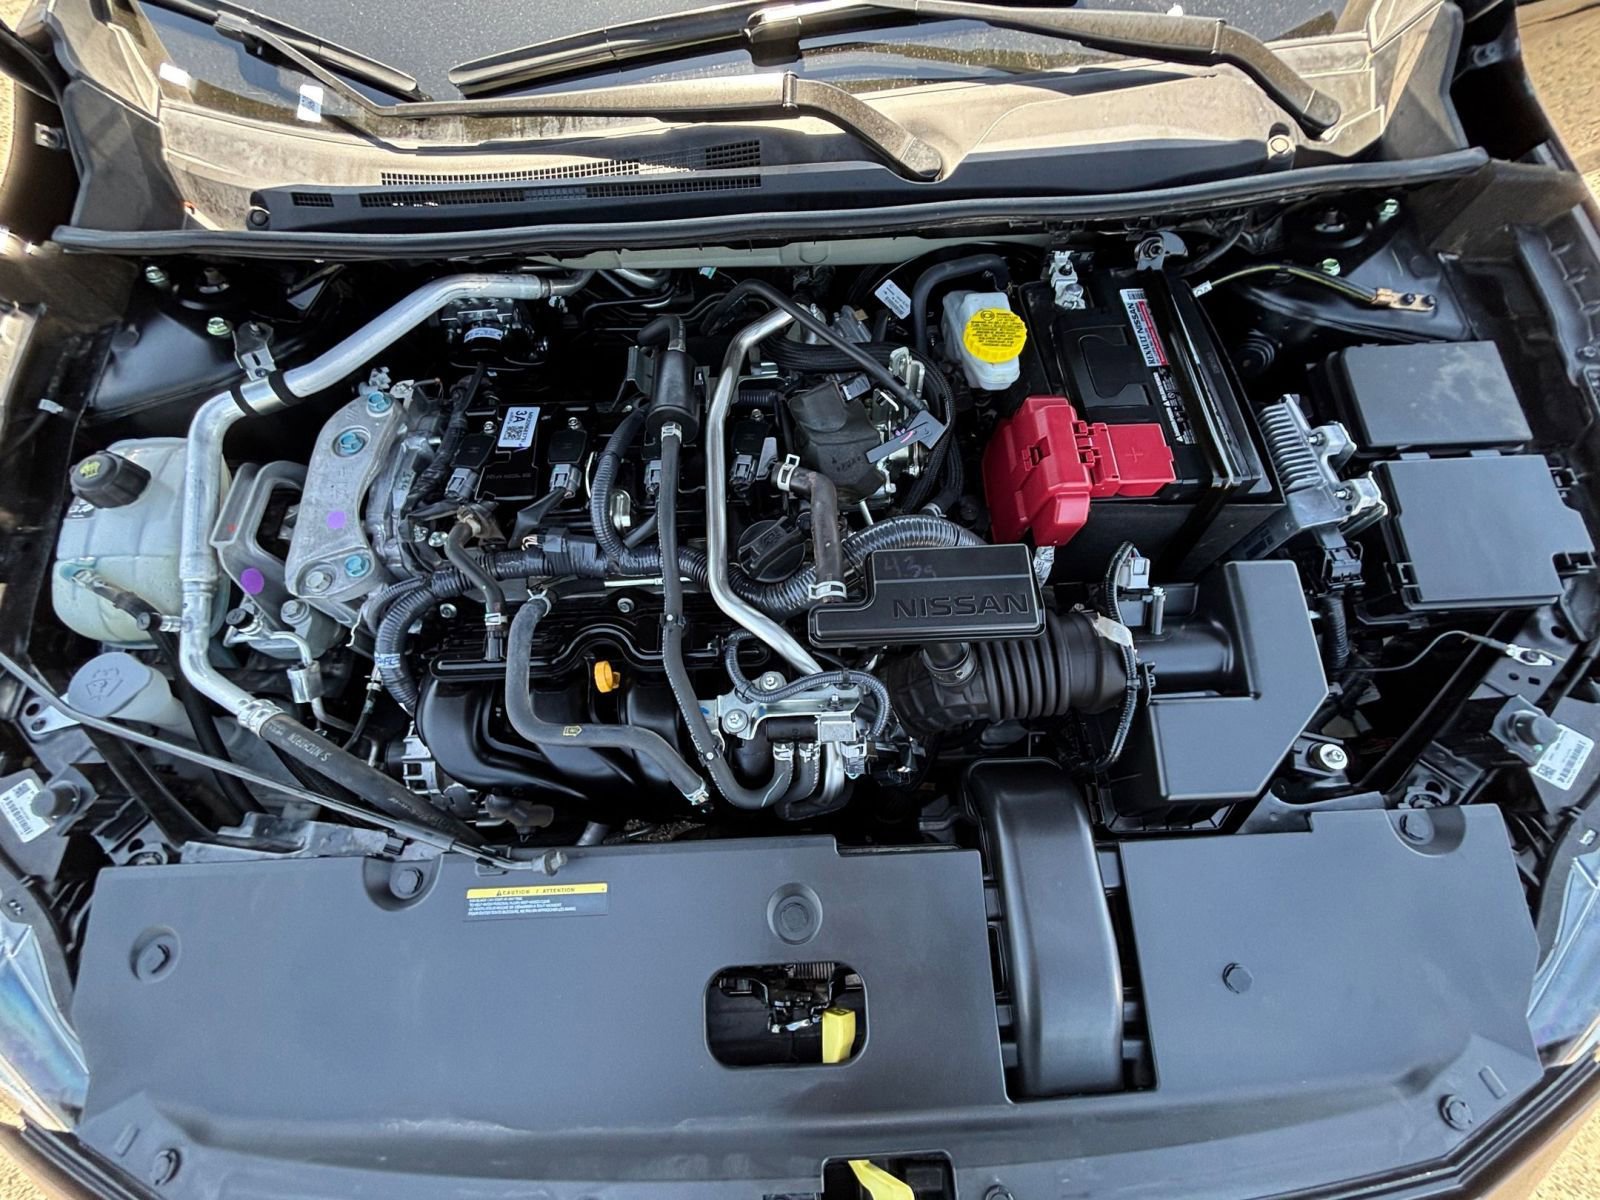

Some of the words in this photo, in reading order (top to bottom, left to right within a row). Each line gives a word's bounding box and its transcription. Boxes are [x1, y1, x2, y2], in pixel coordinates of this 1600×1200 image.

[1127, 302, 1144, 334] NISSAN
[1139, 334, 1156, 365] RENAULT
[513, 410, 528, 423] 3A
[893, 593, 1030, 619] NISSAN
